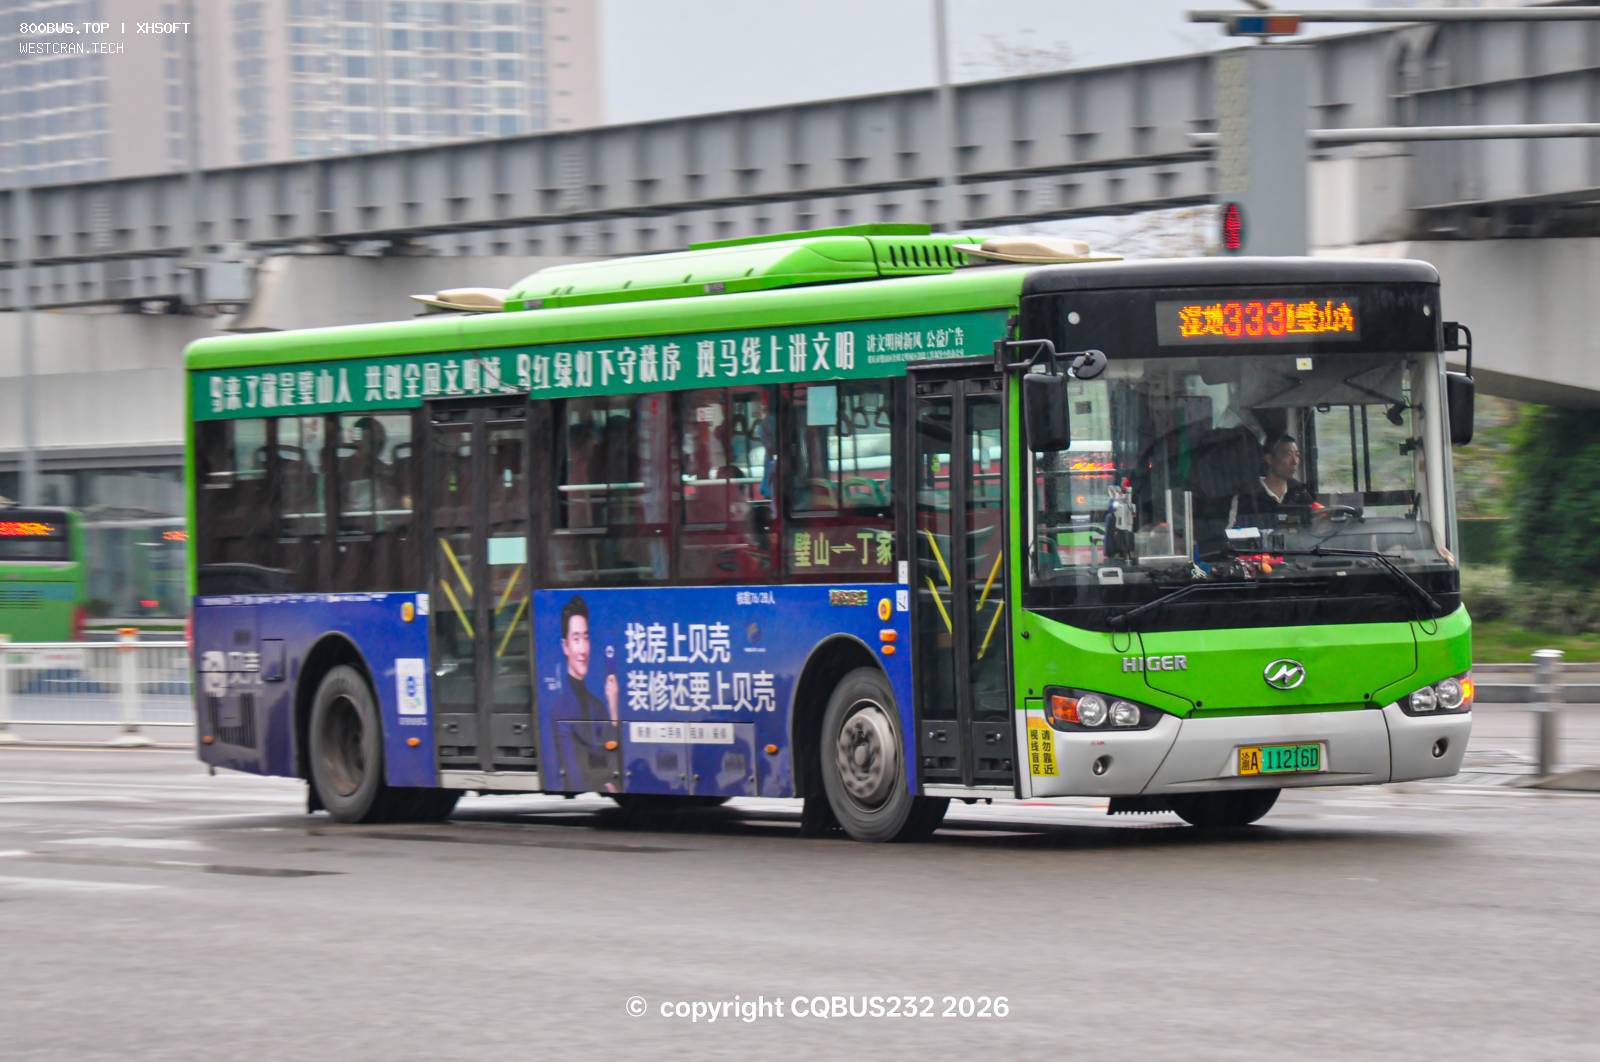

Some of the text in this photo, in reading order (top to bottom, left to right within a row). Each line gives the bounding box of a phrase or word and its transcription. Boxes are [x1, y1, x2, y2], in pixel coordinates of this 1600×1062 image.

[1222, 300, 1287, 338] 333
[696, 331, 855, 378] 斑马线上讲文明
[624, 621, 731, 664] 找房上贝壳
[1122, 654, 1188, 673] HIGER
[627, 669, 776, 713] 装修还要上贝壳
[1041, 729, 1055, 775] 请勿靠近
